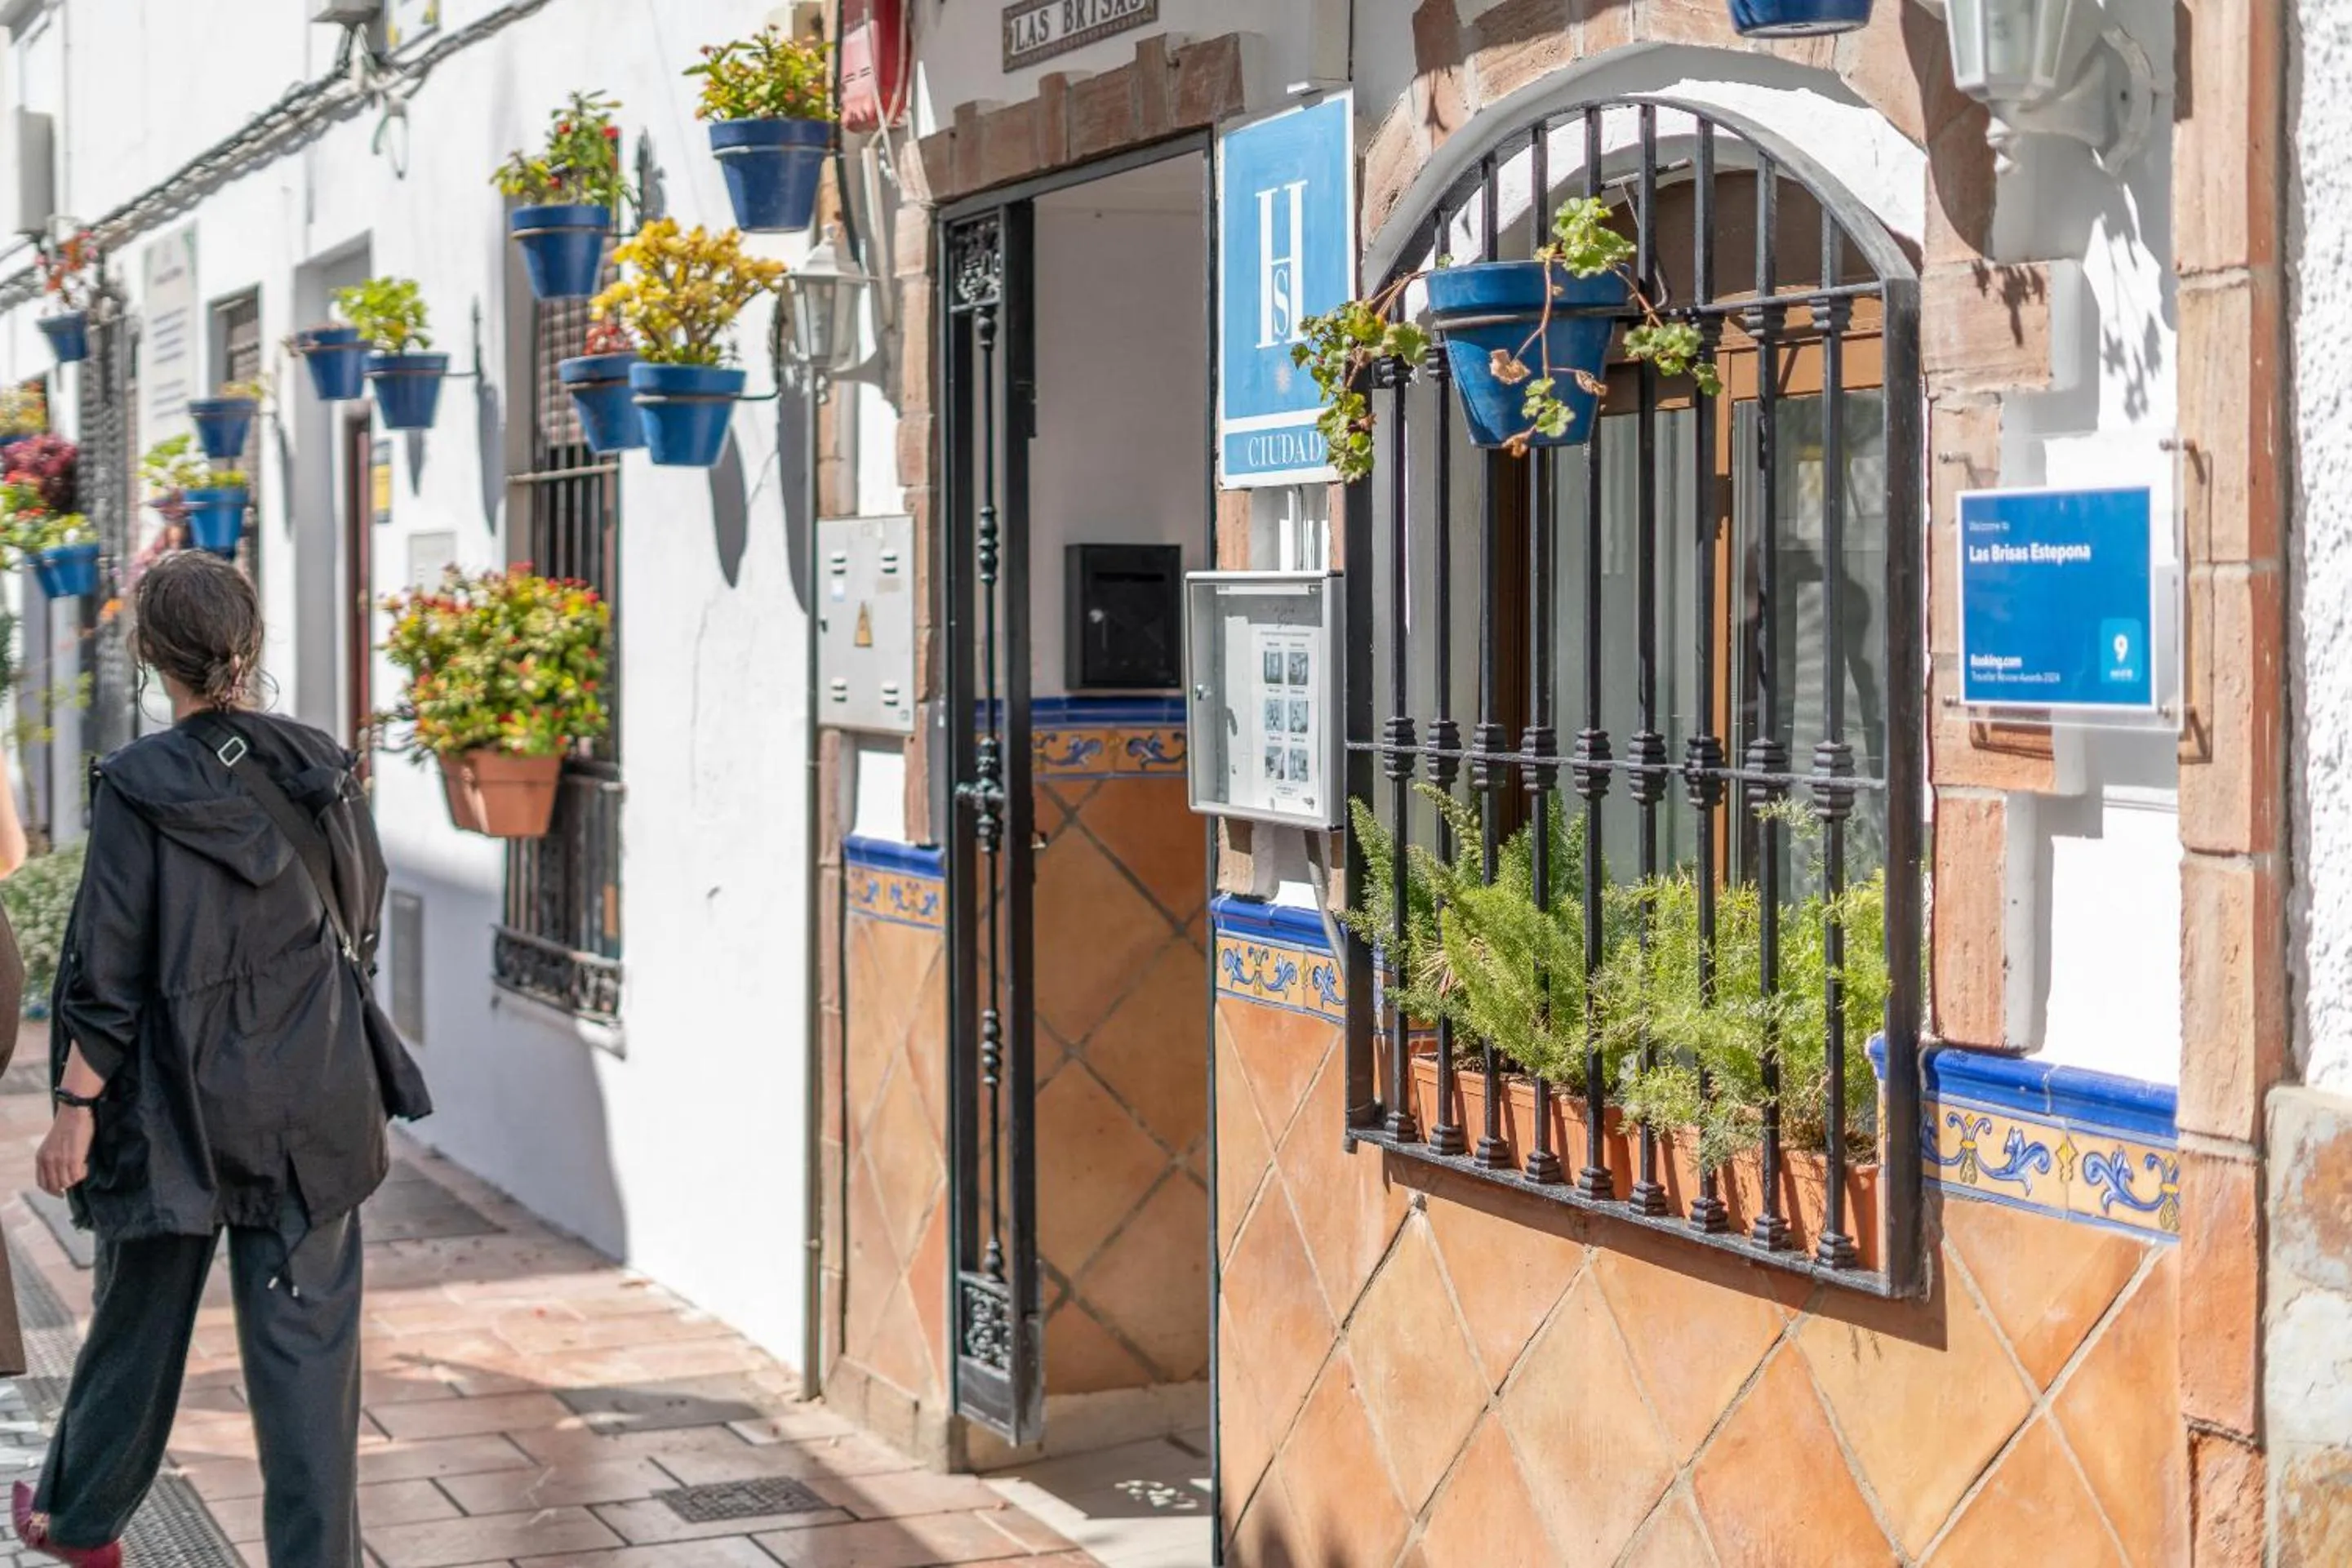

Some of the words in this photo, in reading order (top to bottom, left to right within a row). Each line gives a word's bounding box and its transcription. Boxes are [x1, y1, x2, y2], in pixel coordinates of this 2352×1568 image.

[1015, 9, 1050, 52] LAS
[1063, 0, 1140, 34] BRIS
[1247, 429, 1323, 468] CIUDAD
[1968, 545, 1990, 562] Las
[1990, 544, 2029, 562] Brisas
[2030, 542, 2091, 566] Estepona
[2114, 634, 2127, 662] 9
